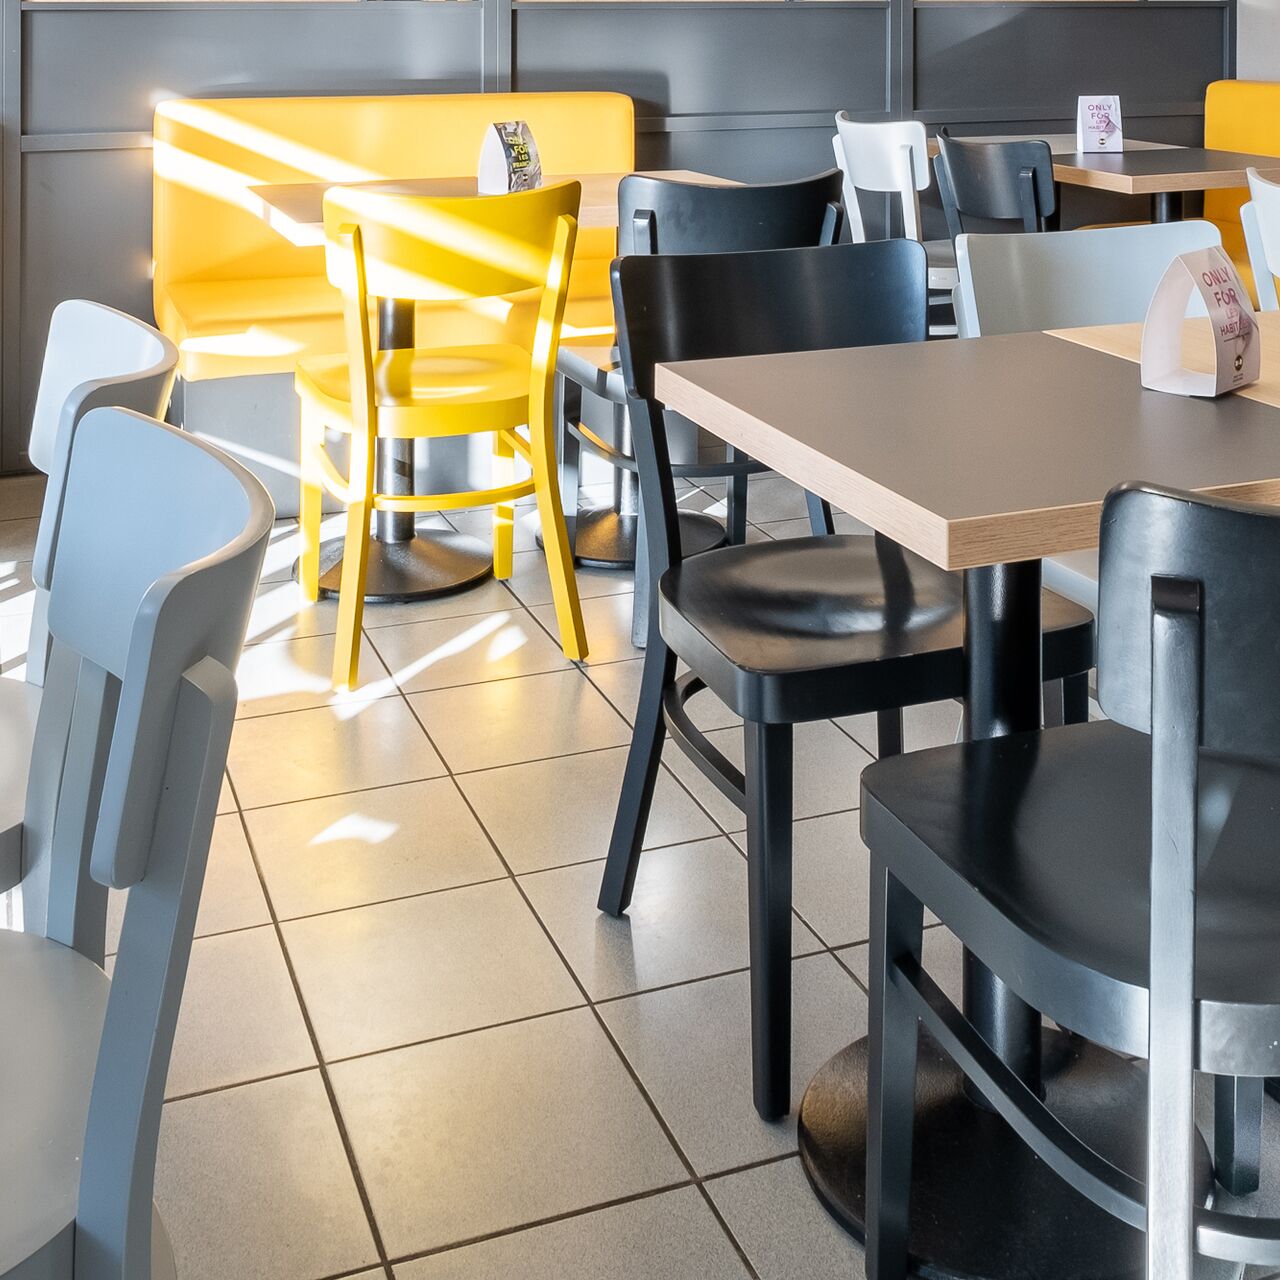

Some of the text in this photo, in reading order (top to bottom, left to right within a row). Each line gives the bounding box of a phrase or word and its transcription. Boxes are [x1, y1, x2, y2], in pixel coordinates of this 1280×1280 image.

[1091, 112, 1110, 120] FOR
[1202, 266, 1232, 288] ONLY
[1214, 287, 1237, 308] FOR
